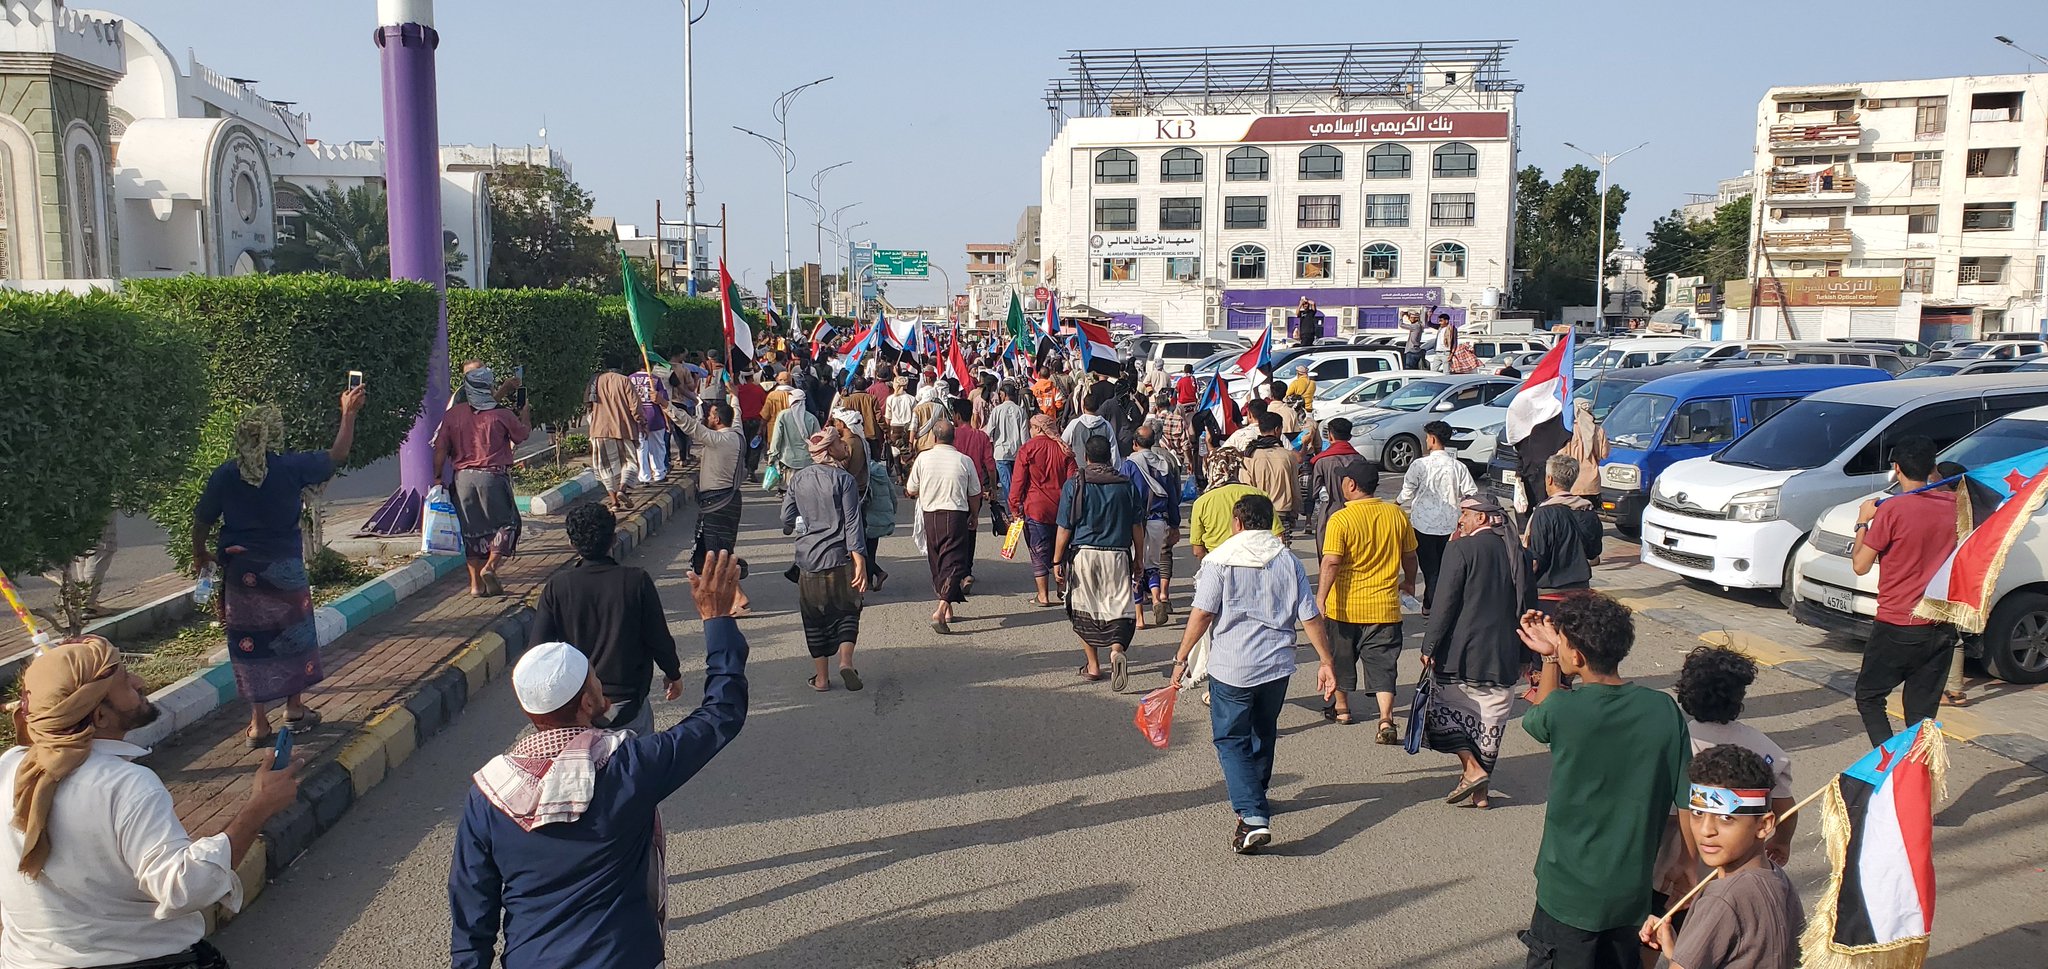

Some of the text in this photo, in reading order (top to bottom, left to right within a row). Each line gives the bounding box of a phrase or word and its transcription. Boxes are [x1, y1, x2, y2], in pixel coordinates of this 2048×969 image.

[1309, 115, 1453, 137] بنك الكريمي الإسلامي
[1107, 235, 1194, 248] معهد الأحقاف العالي
[1828, 279, 1872, 295] التركي
[1827, 596, 1847, 611] 45784
